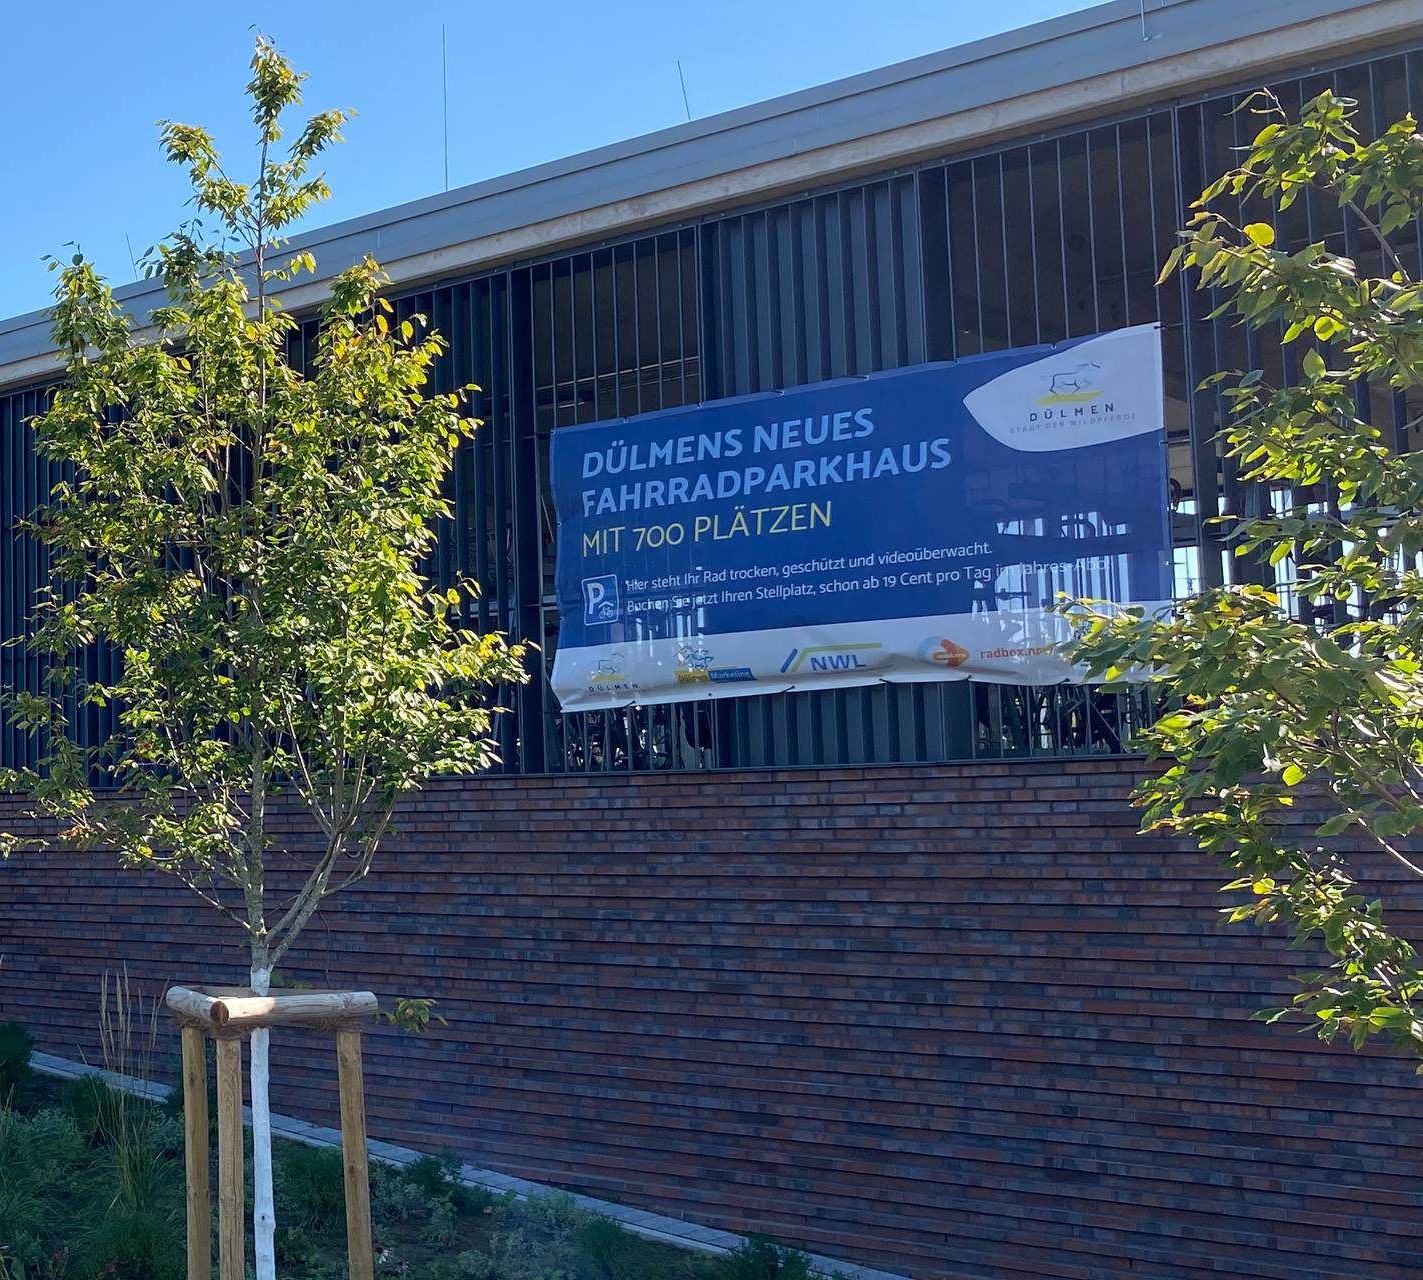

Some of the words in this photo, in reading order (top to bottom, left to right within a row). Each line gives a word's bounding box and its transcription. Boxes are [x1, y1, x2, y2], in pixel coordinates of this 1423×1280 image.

[1010, 424, 1041, 434] STADT
[1045, 421, 1065, 430] DER
[1029, 403, 1114, 422] DÜLMEN
[582, 428, 743, 479] DÜLMENS
[753, 408, 874, 453] NEUES
[581, 438, 952, 518] FAHRRADPARKHAUS
[582, 527, 626, 557] MIT
[632, 523, 685, 552] 700
[694, 501, 832, 542] PLÄTZEN
[626, 579, 648, 592] Hier
[651, 576, 680, 589] steht
[684, 572, 700, 585] Ihr
[703, 569, 727, 583] Rad
[730, 566, 780, 580] trocken,
[782, 557, 846, 577] geschützt
[849, 553, 875, 568] und
[878, 541, 993, 565] videoüberwacht.
[627, 597, 669, 613] Buchen
[692, 594, 718, 610] jetzt
[721, 589, 753, 603] Ihren
[755, 582, 817, 601] Stellplatz,
[820, 578, 859, 594] schon
[862, 576, 879, 590] ab
[882, 575, 897, 588] 19
[900, 571, 933, 587] Cent
[936, 571, 960, 585] pro
[963, 566, 992, 582] Tag
[810, 654, 867, 671] NWL
[980, 647, 1053, 659] radbox.nr
